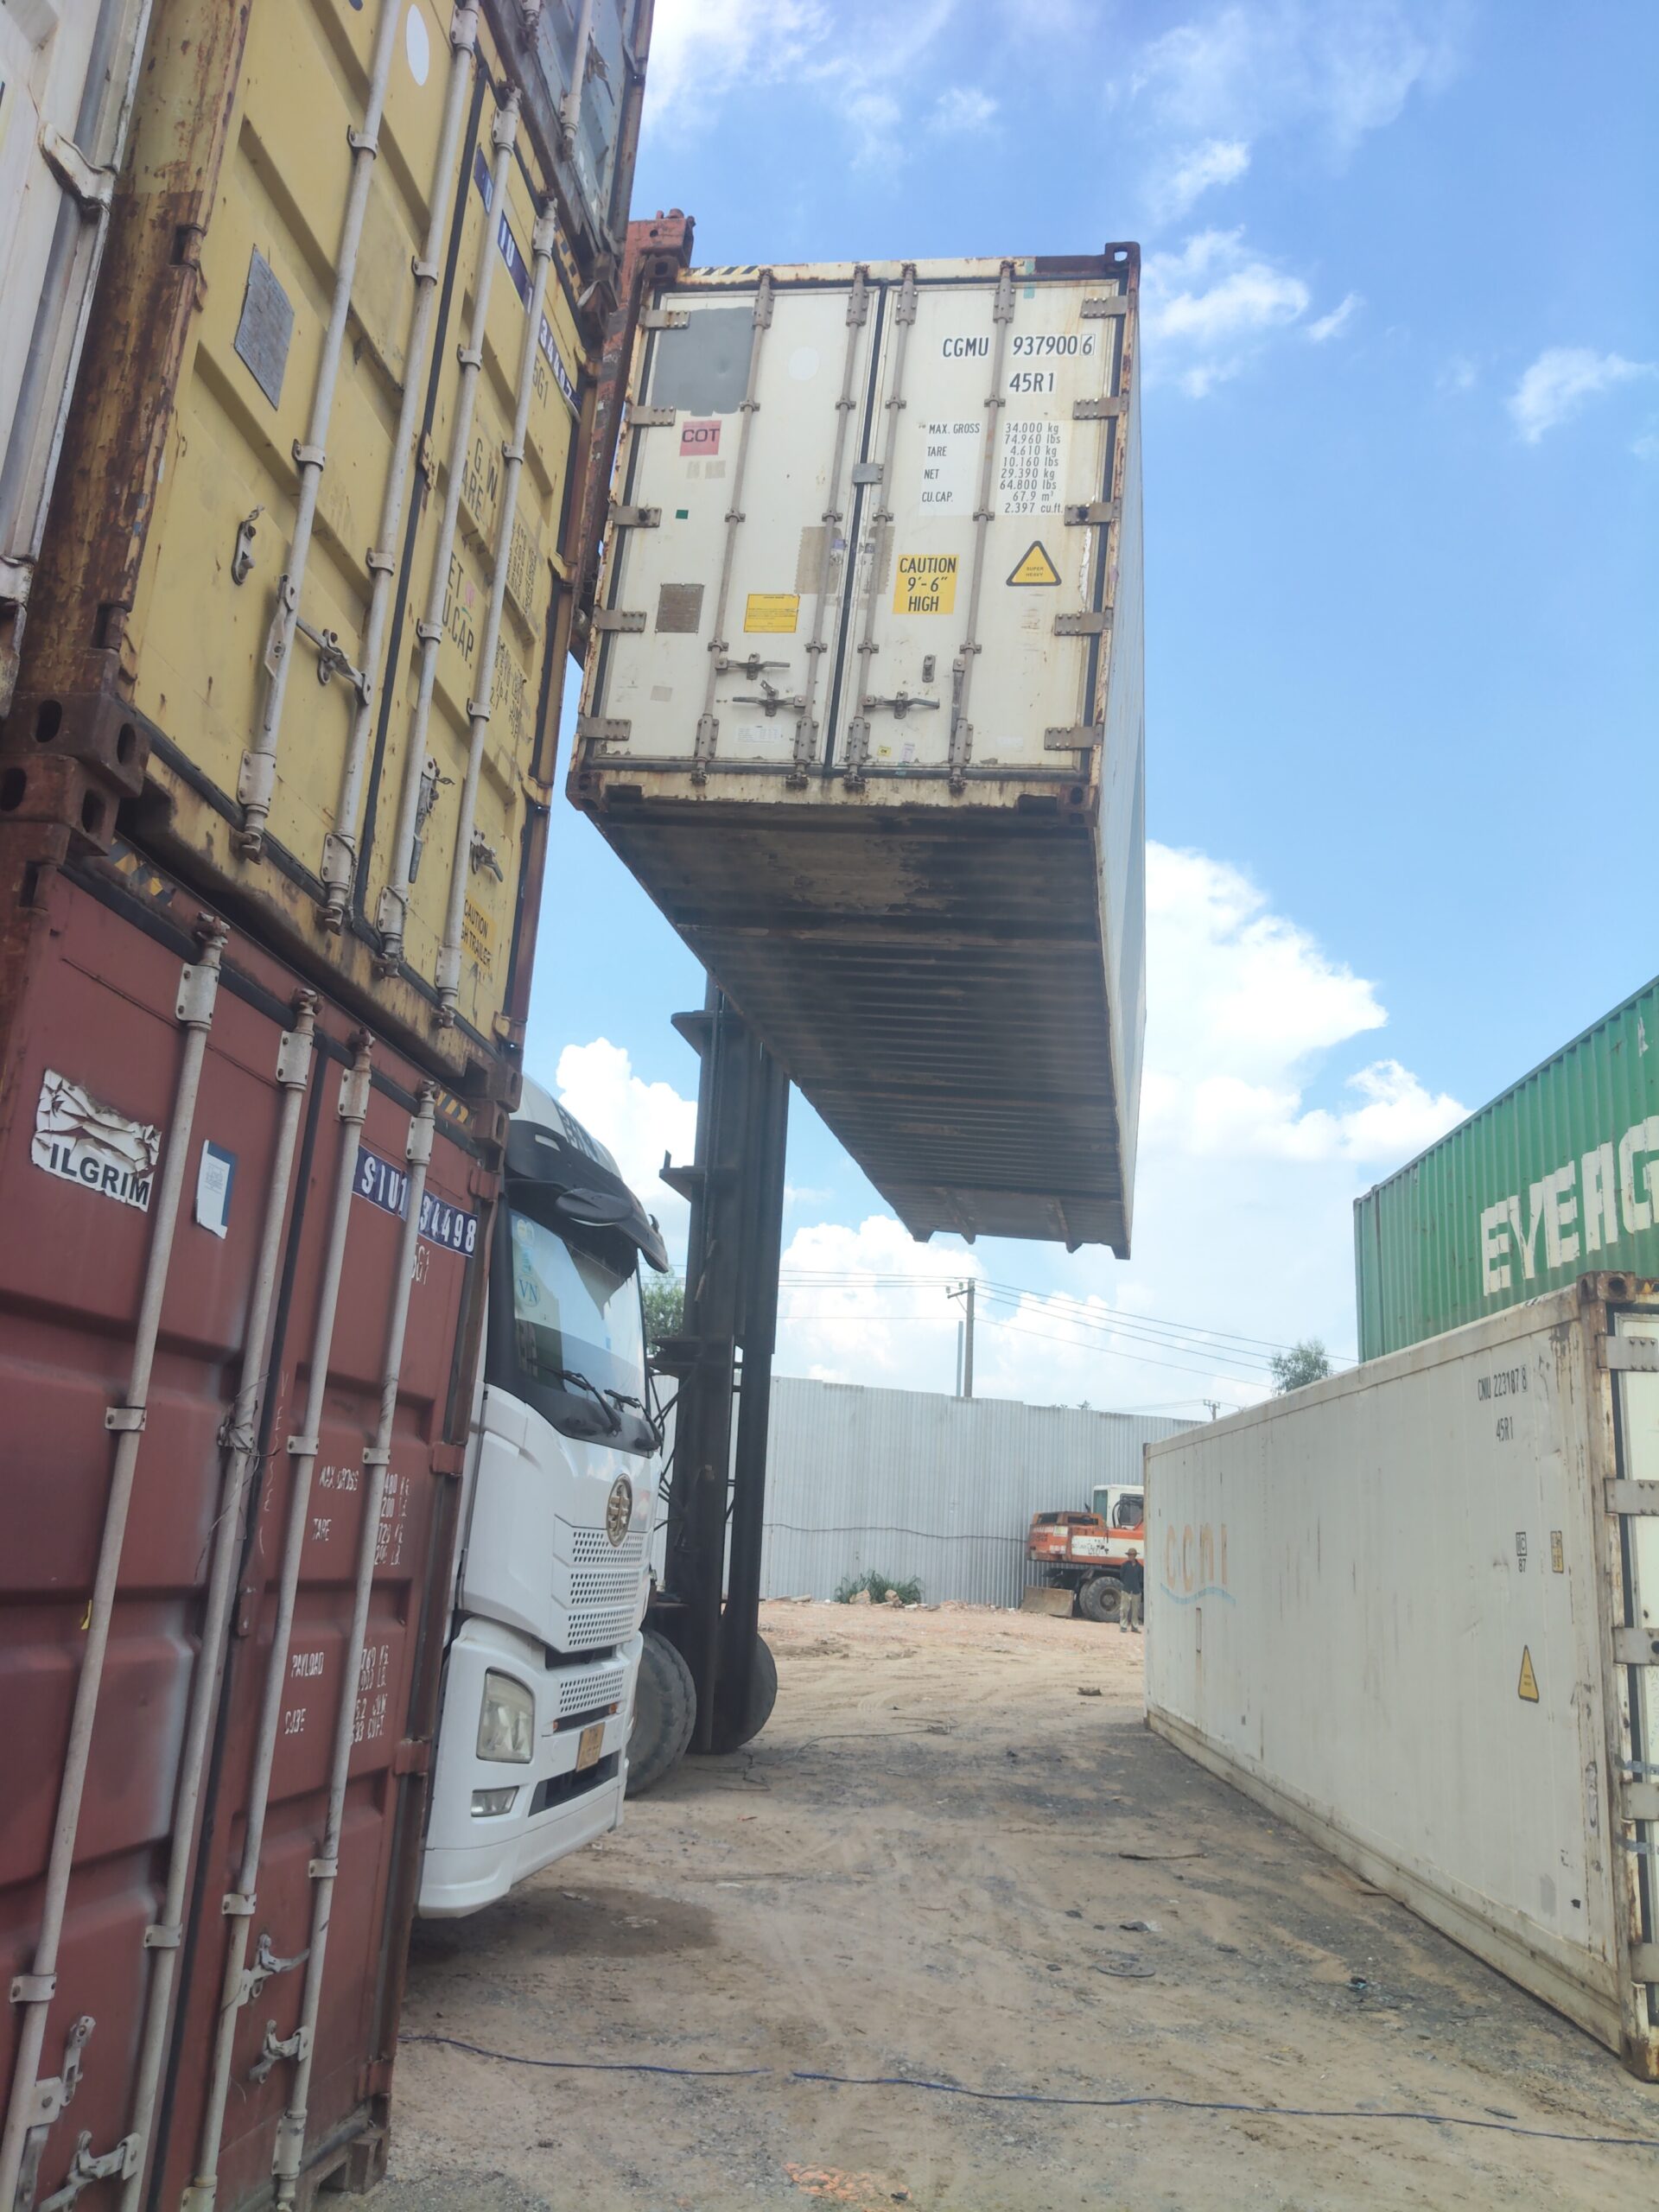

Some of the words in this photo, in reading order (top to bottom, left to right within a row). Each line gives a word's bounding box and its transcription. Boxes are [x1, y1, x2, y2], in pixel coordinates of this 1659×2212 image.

[942, 337, 989, 358] CGMU
[1009, 372, 1054, 392] 45R1
[682, 428, 721, 443] COT
[953, 423, 980, 434] GROSS
[1005, 423, 1042, 433] 34.000
[1047, 423, 1059, 436] kg
[1005, 434, 1041, 444] 74.960
[1046, 434, 1061, 444] lbs
[927, 446, 947, 457] TARE
[1010, 445, 1040, 455] 4.610
[1046, 445, 1057, 458] kg
[1003, 456, 1039, 467] 10.160
[1045, 456, 1058, 467] lbs
[924, 468, 939, 480] NET
[1001, 468, 1039, 479] 29.390
[1044, 468, 1055, 480] kg
[1000, 480, 1038, 490] 64.800
[1042, 480, 1057, 490] lbs
[1013, 491, 1036, 502] 67.9
[1004, 503, 1035, 513] 2.397
[899, 557, 957, 574] CAUTION
[907, 595, 939, 612] HIGH
[464, 899, 488, 939] CAUTION
[1497, 1416, 1514, 1442] 45R1
[313, 1518, 332, 1541] TARE
[1518, 1558, 1526, 1573] 87
[291, 1651, 325, 1678] PAYLOAD
